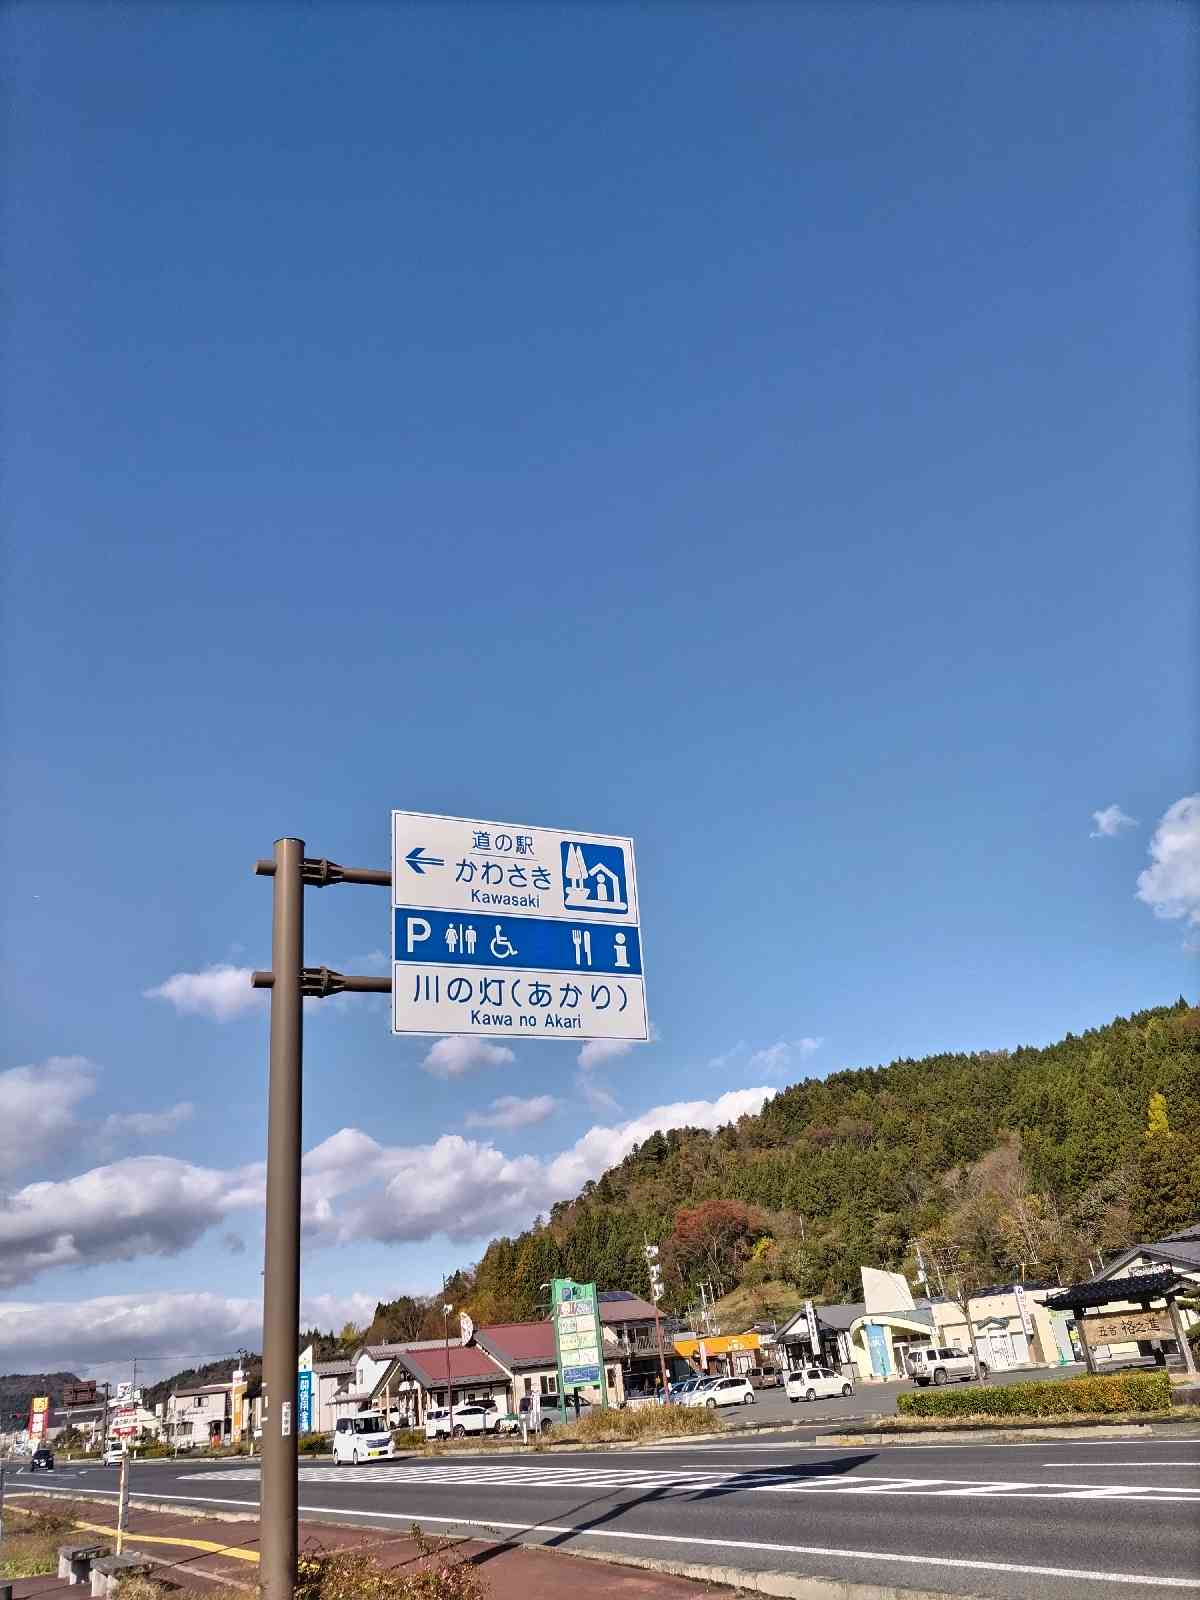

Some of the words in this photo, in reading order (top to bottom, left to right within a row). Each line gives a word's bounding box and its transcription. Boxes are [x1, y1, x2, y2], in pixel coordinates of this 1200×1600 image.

[472, 830, 534, 855] 道の駅
[455, 858, 552, 890] かわさき
[471, 889, 540, 908] Kawasaki
[471, 1010, 513, 1026] Kawa
[519, 1015, 537, 1027] no
[544, 1013, 582, 1029] Akari
